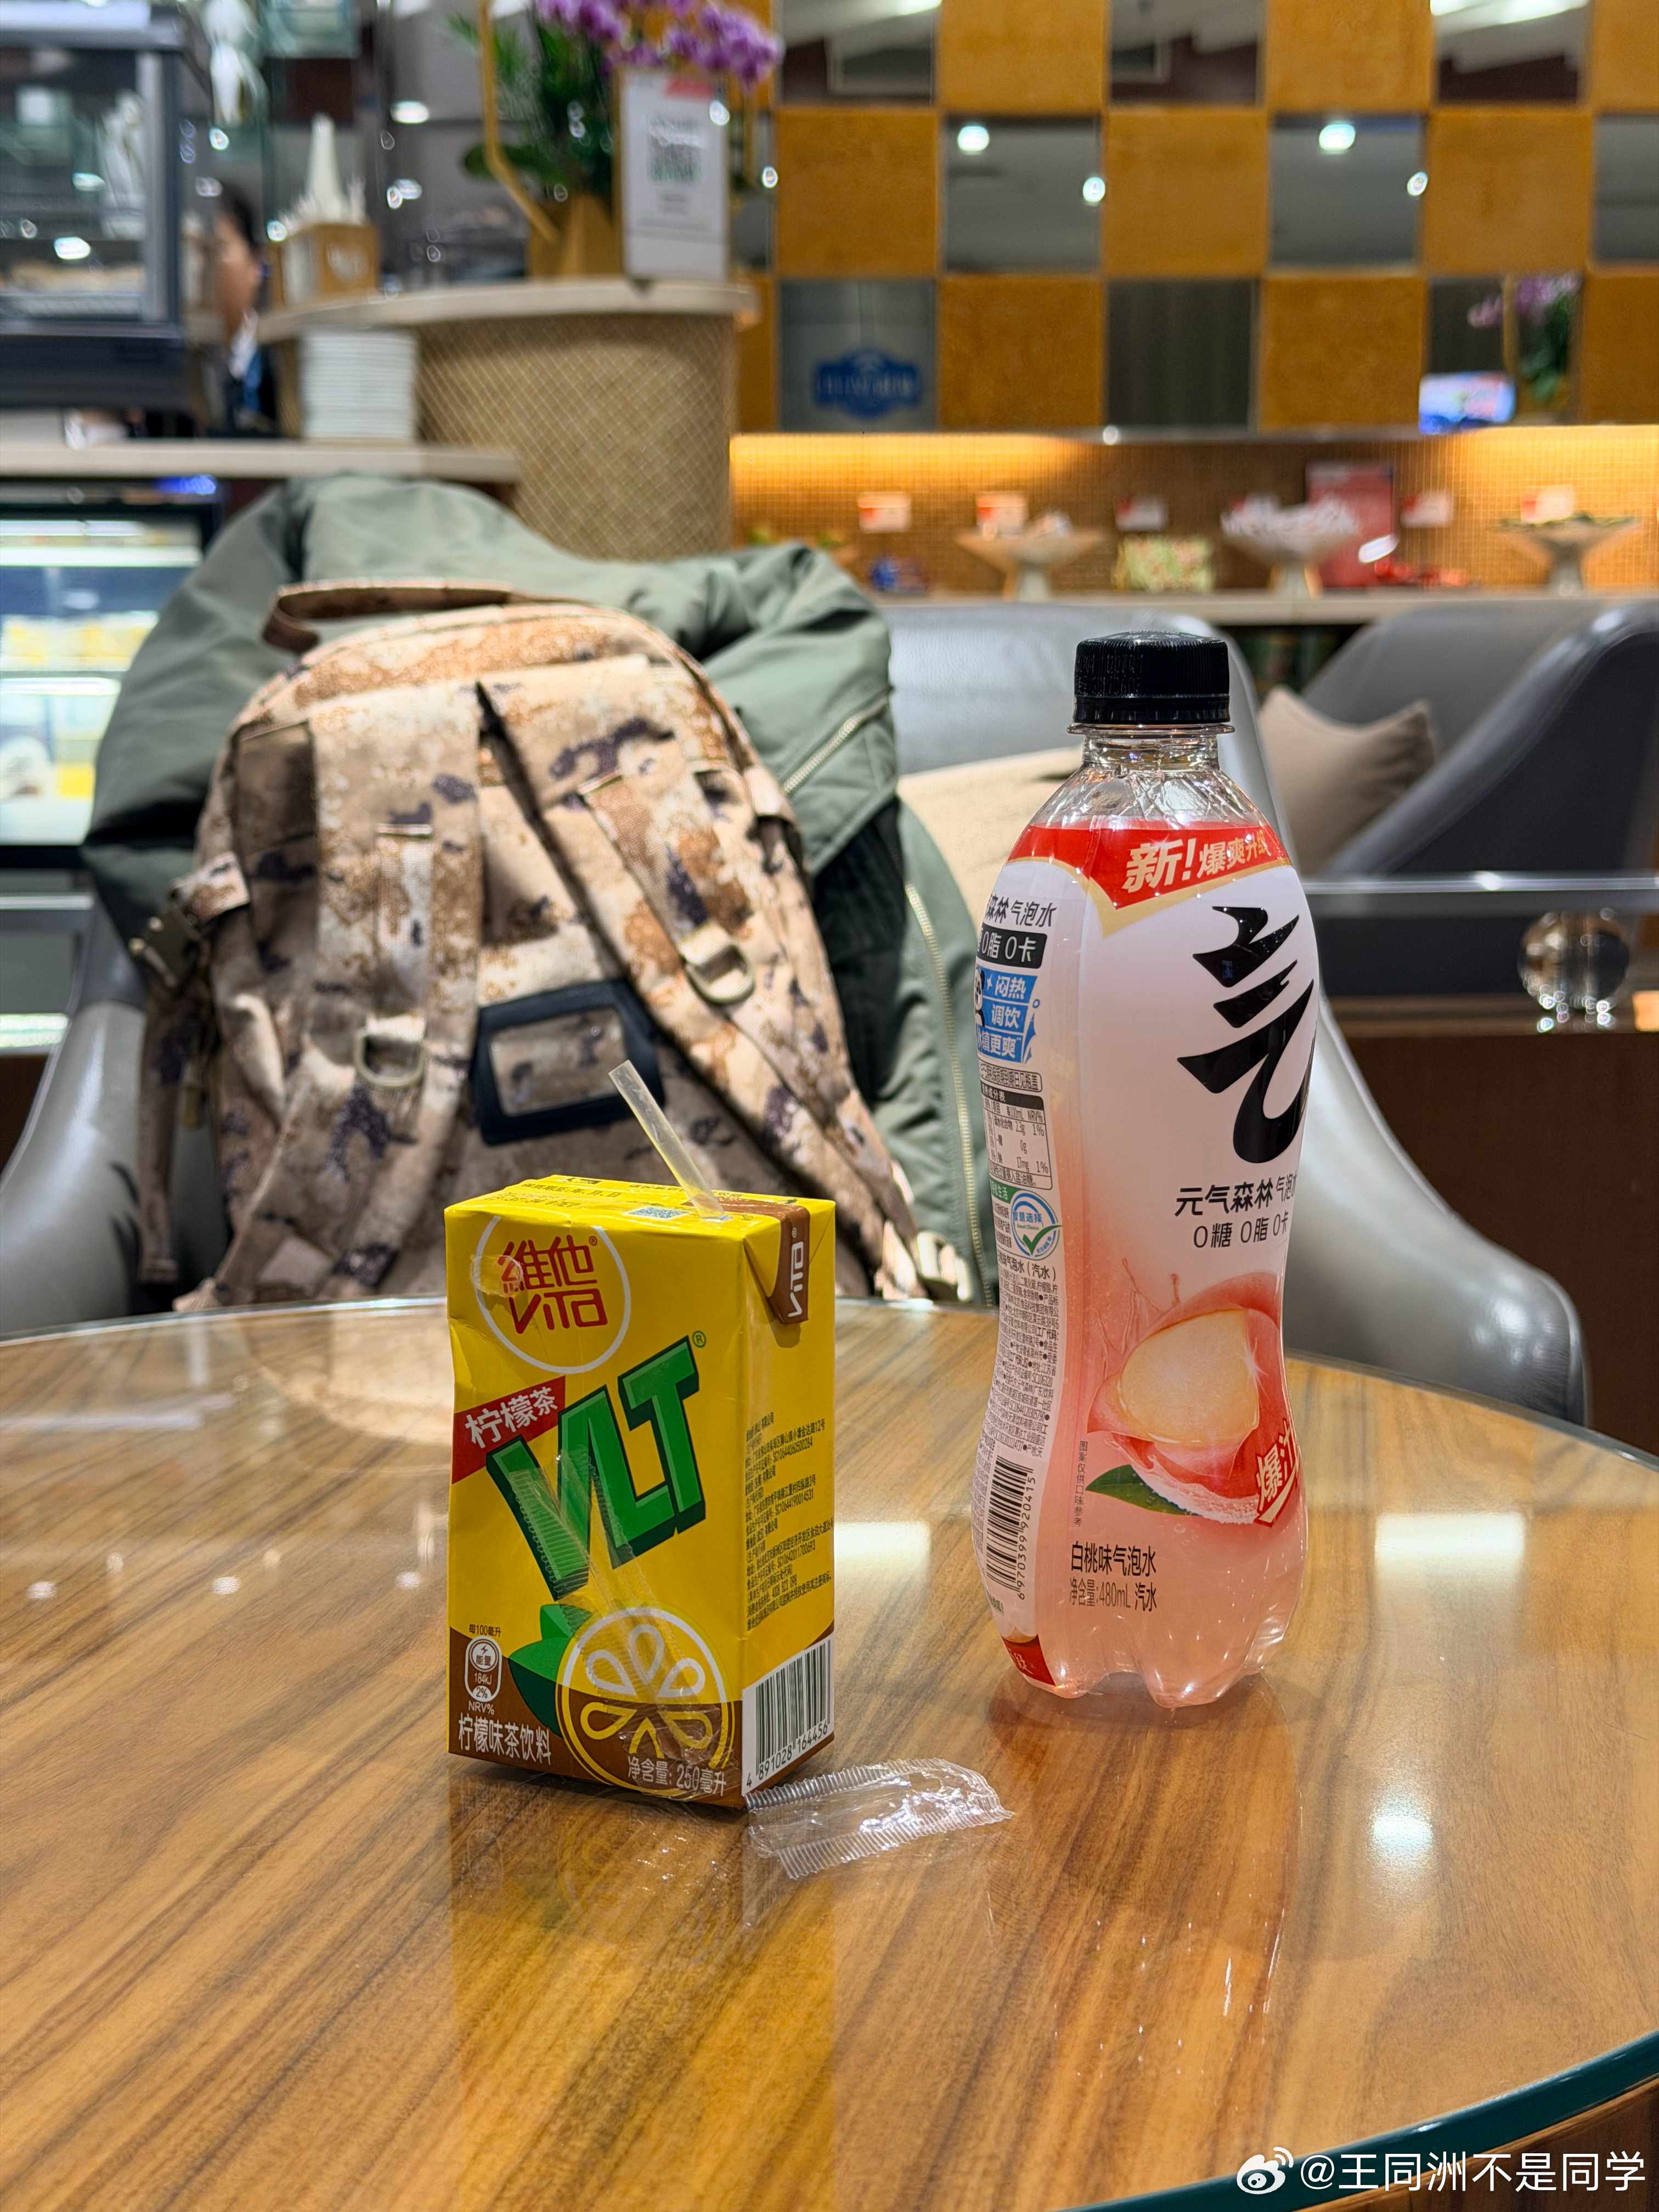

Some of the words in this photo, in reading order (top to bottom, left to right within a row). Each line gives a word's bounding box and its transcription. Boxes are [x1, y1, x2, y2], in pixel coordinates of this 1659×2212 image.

[994, 975, 1026, 1000] 闷热
[991, 1004, 1021, 1029] 调饮
[1028, 1109, 1043, 1122] NRV%
[1032, 1124, 1045, 1136] 1%
[1020, 1139, 1028, 1154] 0g
[1036, 1160, 1049, 1174] 1%
[1193, 1222, 1233, 1248] 0糖
[1240, 1216, 1269, 1243] 0脂
[465, 1386, 558, 1449] 柠檬茶
[486, 1335, 706, 1602] VLT
[1074, 1441, 1088, 1527] 图案仅供口味参考
[1071, 1541, 1156, 1577] 白桃味气泡水
[1135, 1582, 1157, 1612] 汽水
[469, 1624, 501, 1638] 每100毫升
[476, 1655, 492, 1667] 能量
[474, 1672, 493, 1685] 184kJ
[476, 1687, 488, 1699] 2%
[468, 1701, 495, 1715] NRV%
[458, 1712, 551, 1765] 柠檬味茶饮料
